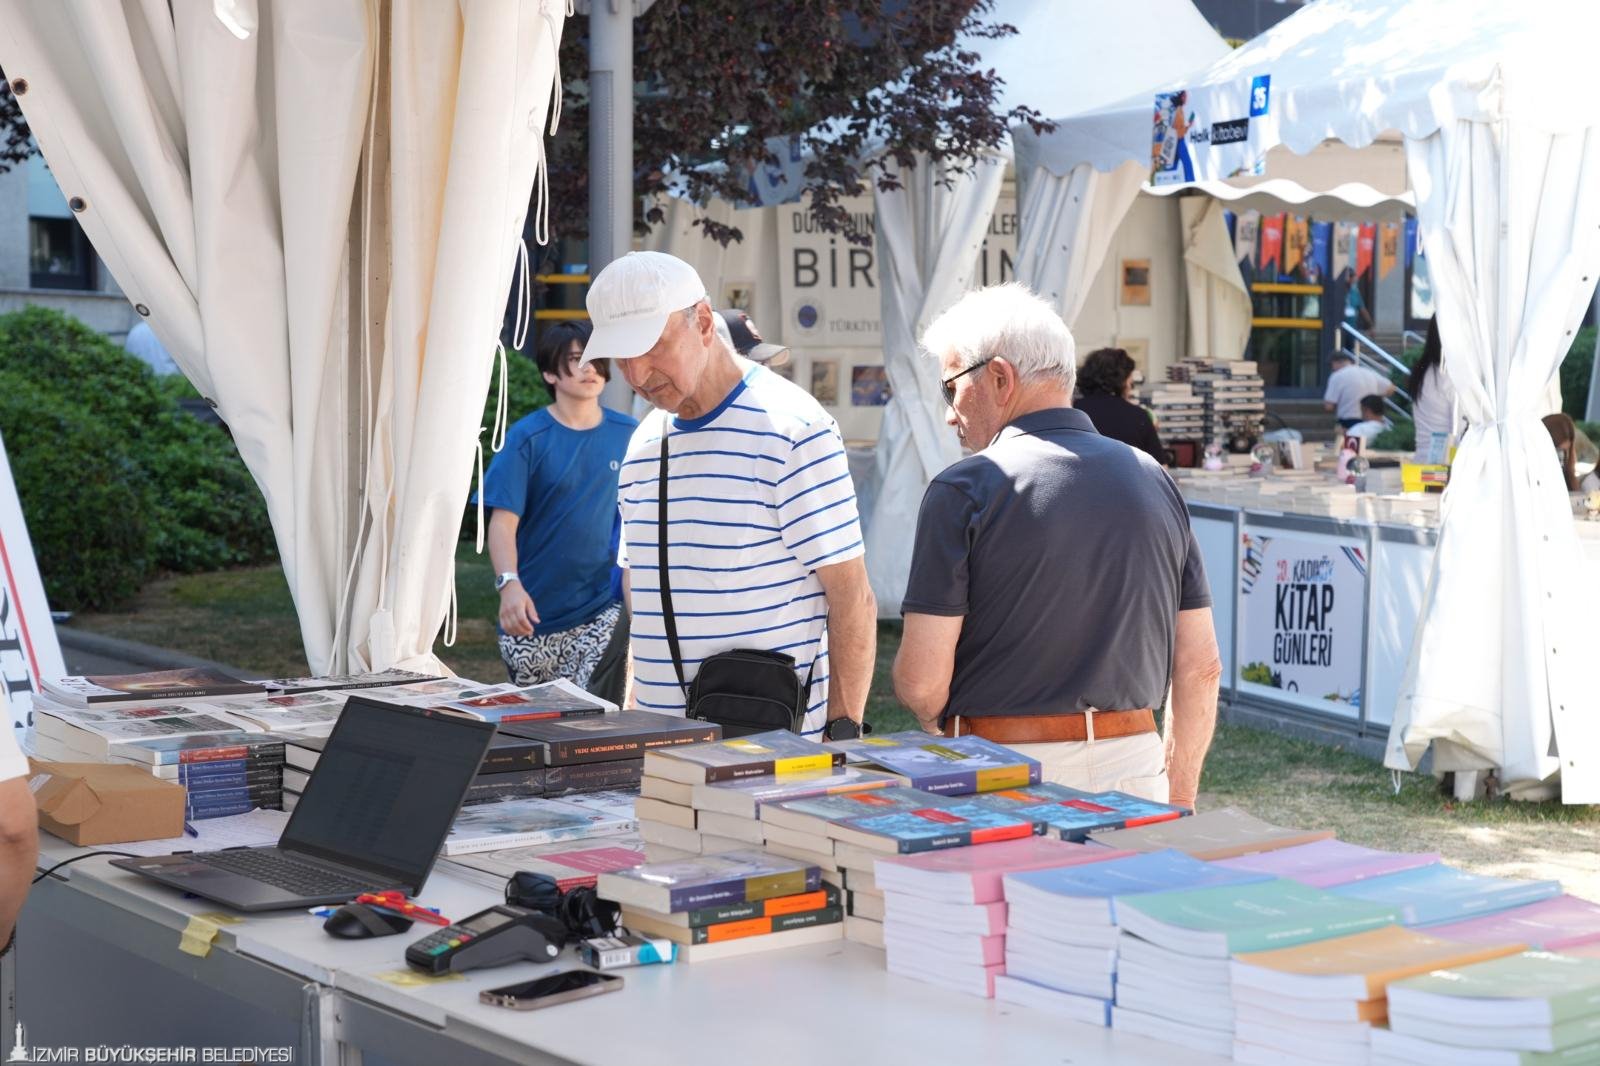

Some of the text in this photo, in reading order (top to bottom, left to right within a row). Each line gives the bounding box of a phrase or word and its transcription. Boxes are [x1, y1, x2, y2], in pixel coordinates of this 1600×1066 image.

[1253, 86, 1268, 110] 35
[794, 237, 876, 288] BİR
[1274, 582, 1335, 632] KİTAP
[1273, 627, 1333, 668] GÜNLERİ
